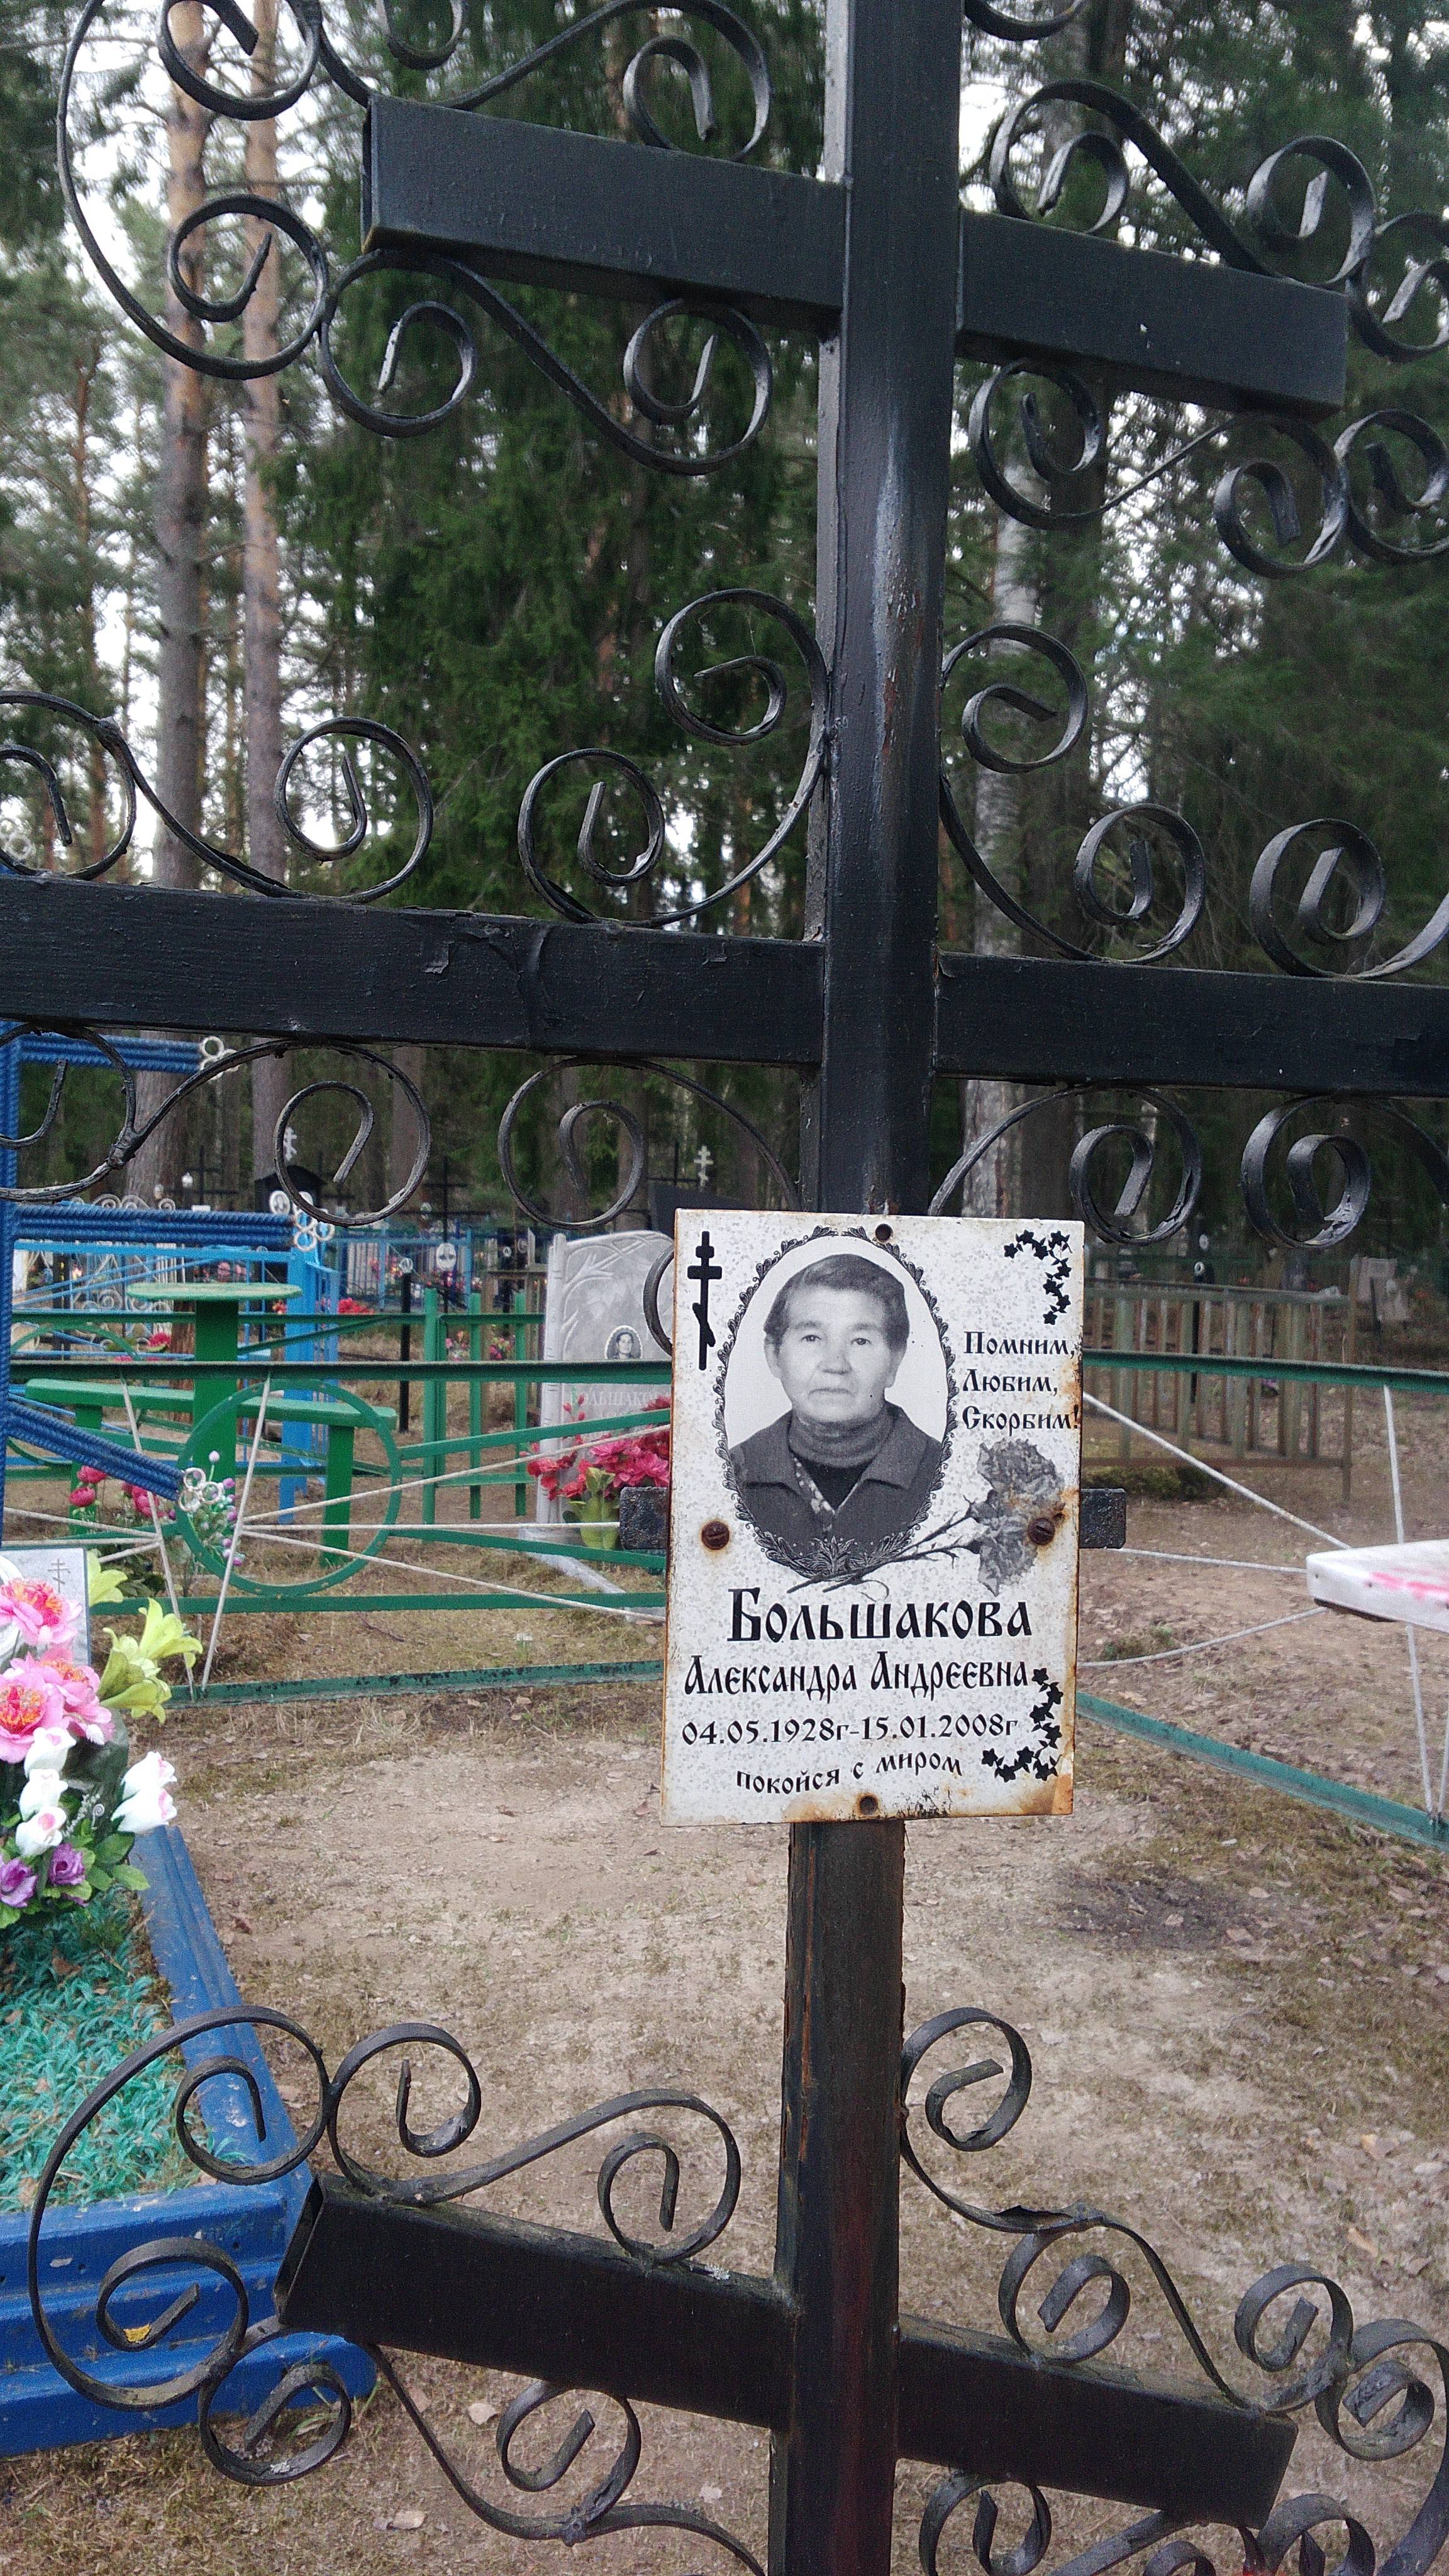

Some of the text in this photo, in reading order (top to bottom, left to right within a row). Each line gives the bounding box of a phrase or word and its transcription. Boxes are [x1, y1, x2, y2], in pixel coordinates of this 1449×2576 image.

[963, 1331, 1075, 1359] Помним,
[962, 1368, 1058, 1396] Любим,
[962, 1404, 1079, 1436] Скорбим!
[727, 1586, 1032, 1643] Большакова
[684, 1651, 1028, 1704] Александра Андреевна
[736, 1752, 962, 1794] покойся с миром
